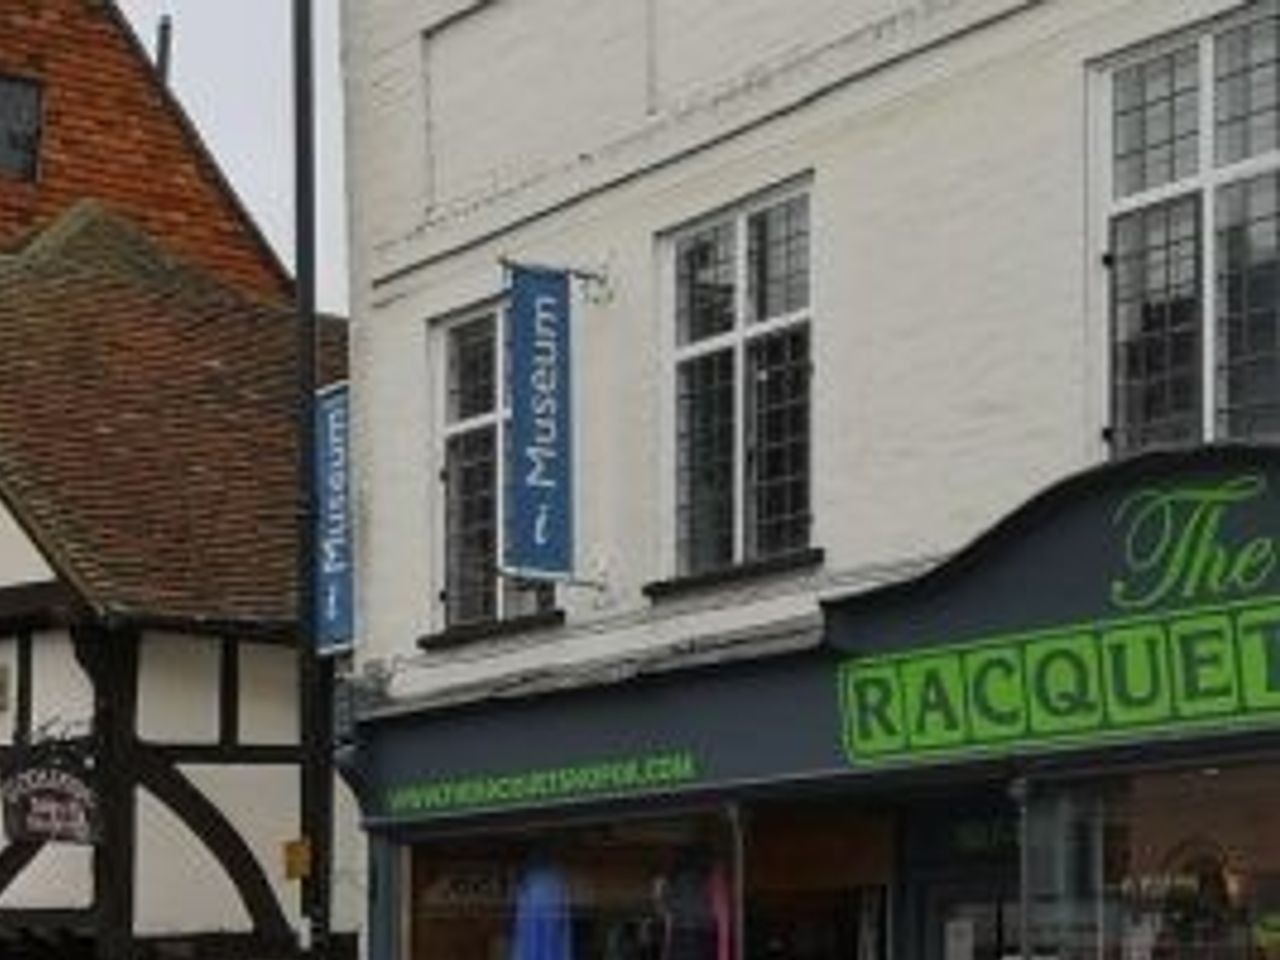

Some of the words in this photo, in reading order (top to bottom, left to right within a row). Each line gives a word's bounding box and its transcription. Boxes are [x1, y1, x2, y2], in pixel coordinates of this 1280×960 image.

[525, 297, 560, 488] Museum
[322, 407, 348, 575] Museum
[1111, 475, 1278, 607] The
